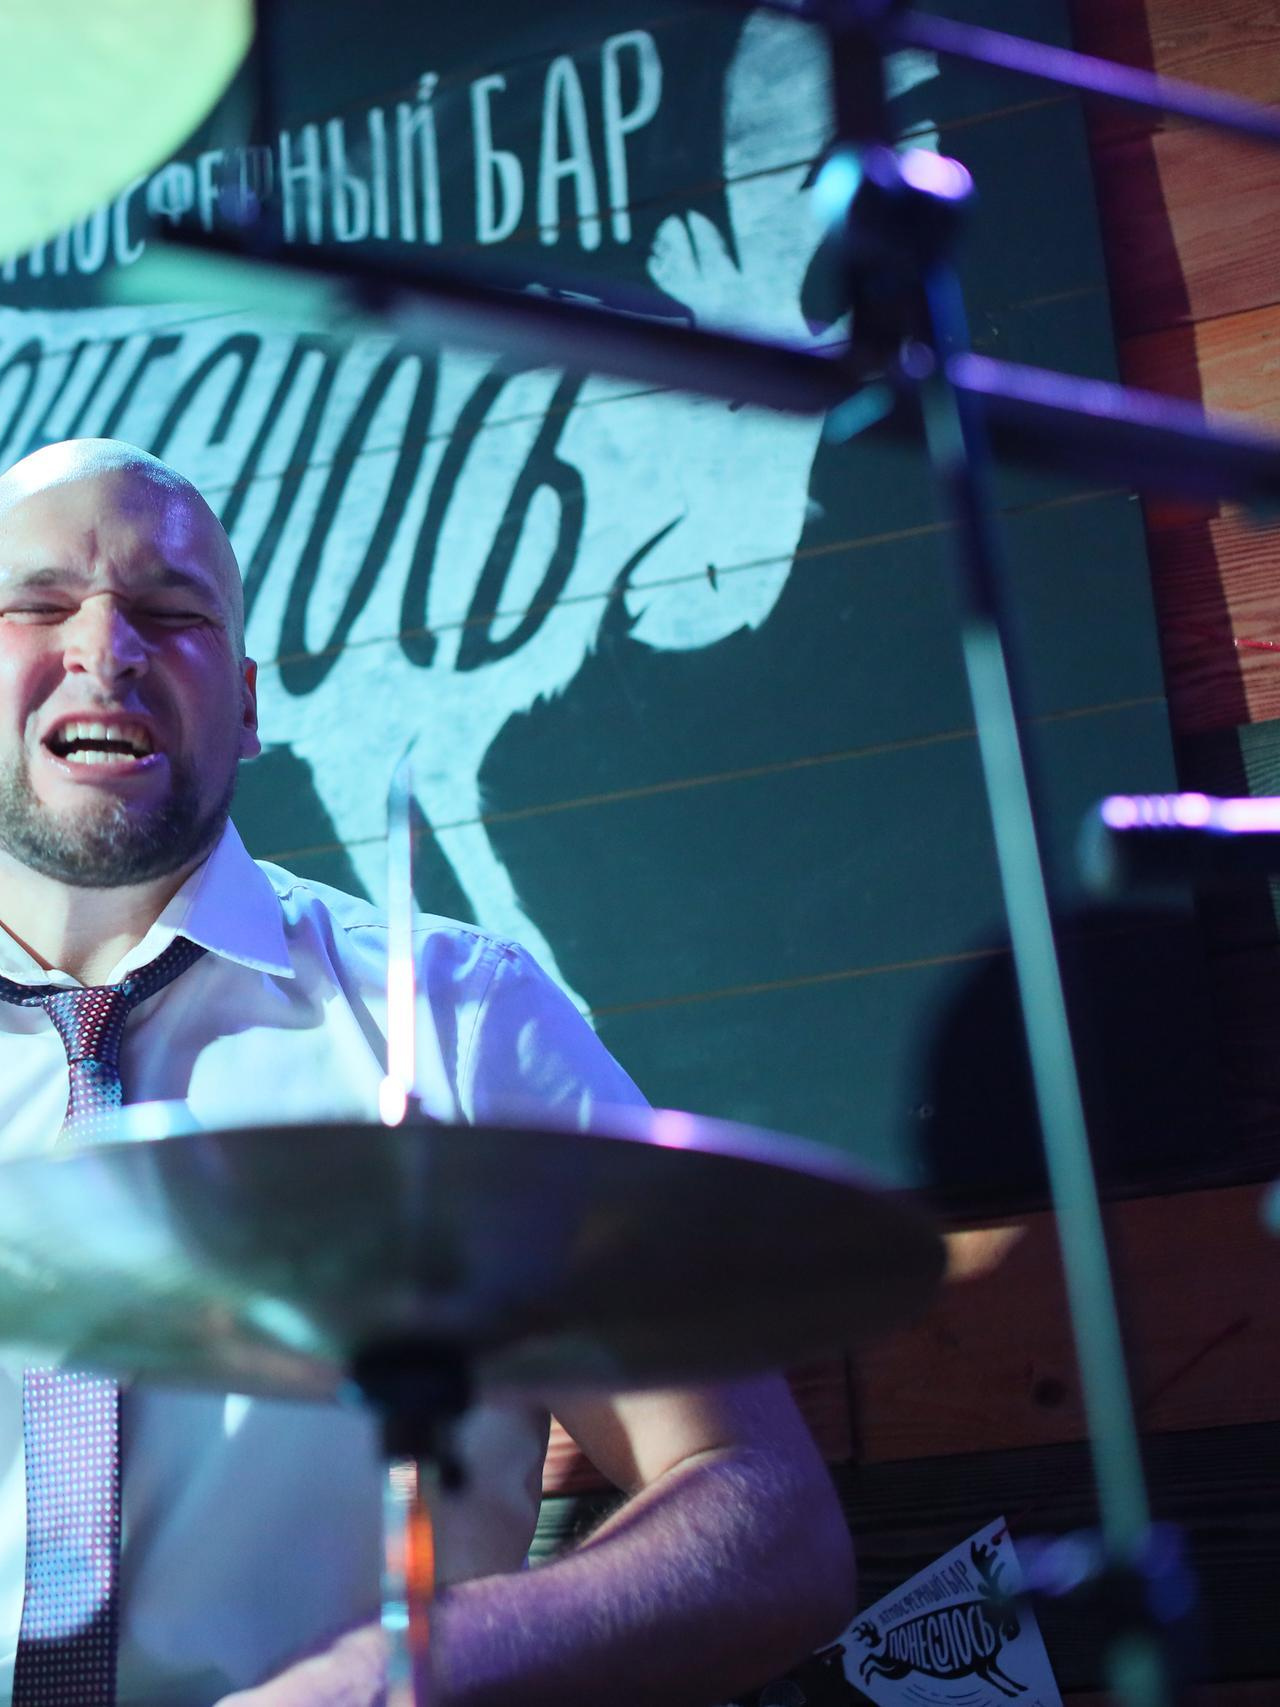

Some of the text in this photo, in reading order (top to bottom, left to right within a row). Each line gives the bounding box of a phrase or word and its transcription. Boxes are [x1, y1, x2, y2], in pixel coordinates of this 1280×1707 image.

[470, 29, 663, 252] БАР
[940, 1559, 976, 1596] БАР
[889, 1603, 996, 1674] ПОНЕСЛОСЬ
